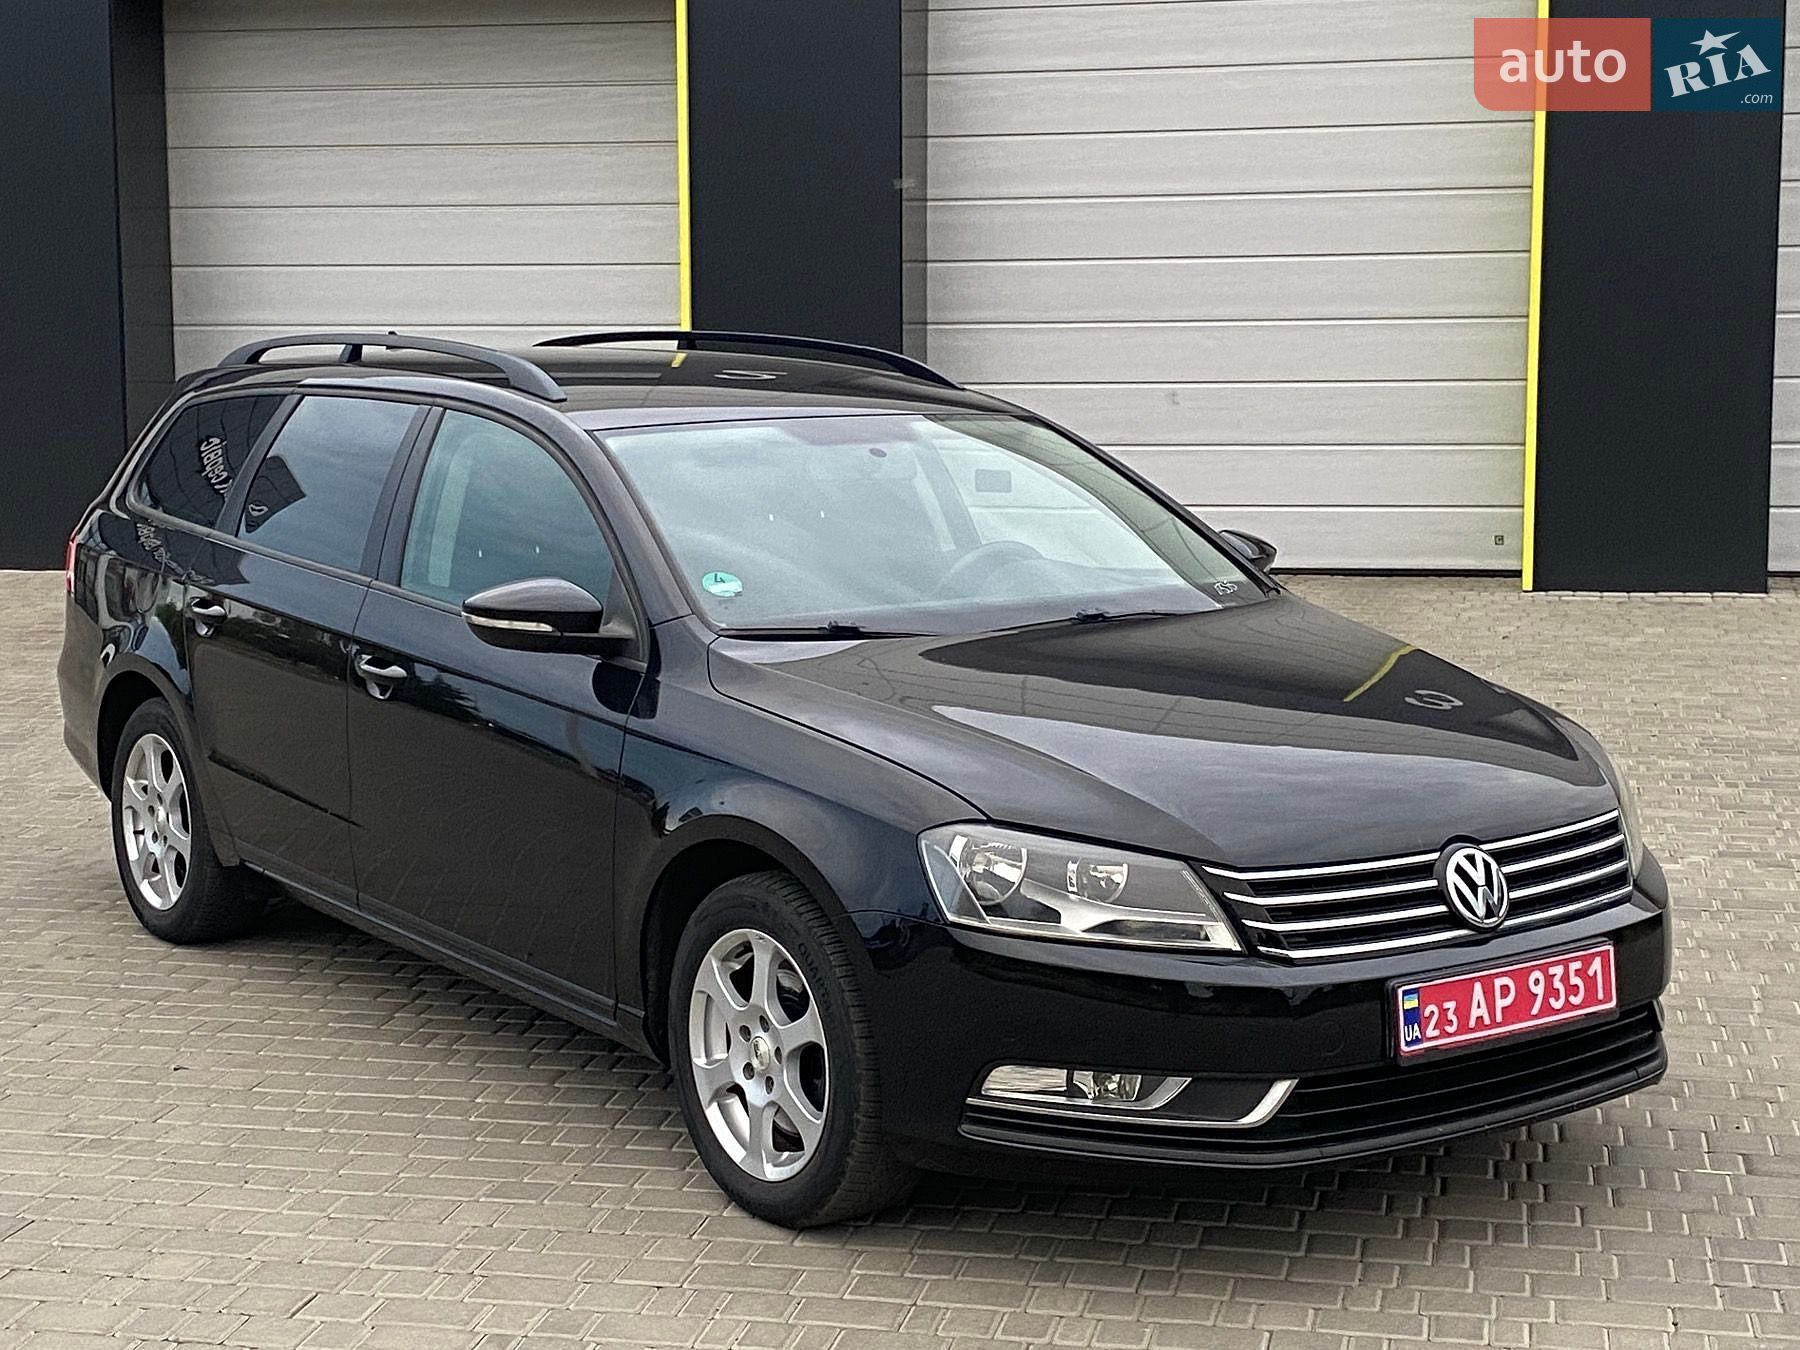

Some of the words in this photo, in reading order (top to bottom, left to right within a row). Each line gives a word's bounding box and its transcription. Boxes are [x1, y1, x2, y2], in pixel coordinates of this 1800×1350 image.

[1423, 1000, 1458, 1039] 23
[1468, 976, 1516, 1029] AP
[1528, 955, 1604, 1016] 9351
[1404, 1024, 1421, 1042] UA
